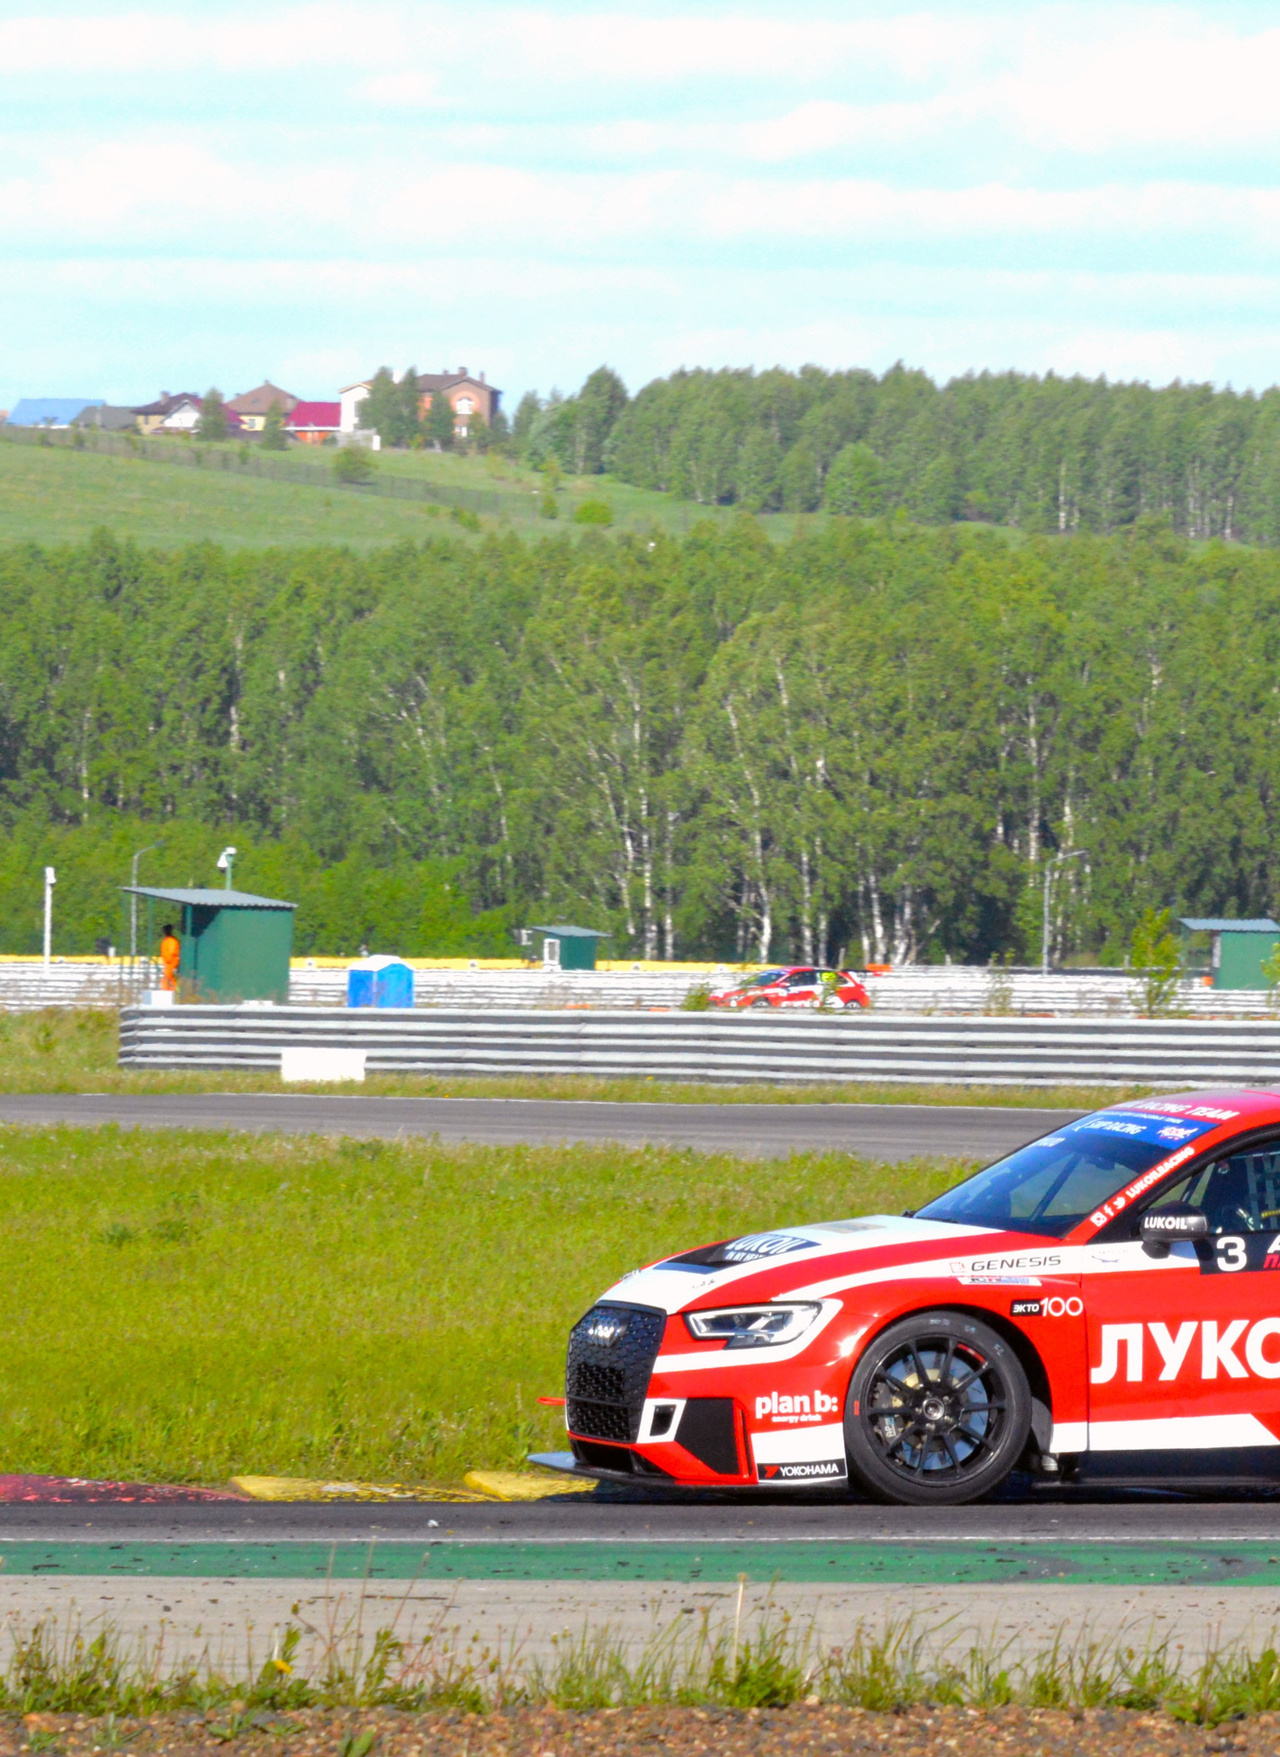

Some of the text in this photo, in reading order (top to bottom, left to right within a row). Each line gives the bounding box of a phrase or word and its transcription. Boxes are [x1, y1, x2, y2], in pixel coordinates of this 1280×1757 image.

[1185, 1106, 1240, 1120] TEAM
[1144, 1216, 1187, 1230] LUKOIL
[1216, 1236, 1248, 1272] 3
[971, 1255, 1061, 1272] GENESIS
[1012, 1297, 1083, 1317] ЭКТО 100
[755, 1390, 838, 1419] plan b:
[780, 1462, 839, 1477] YOKOHAMA
